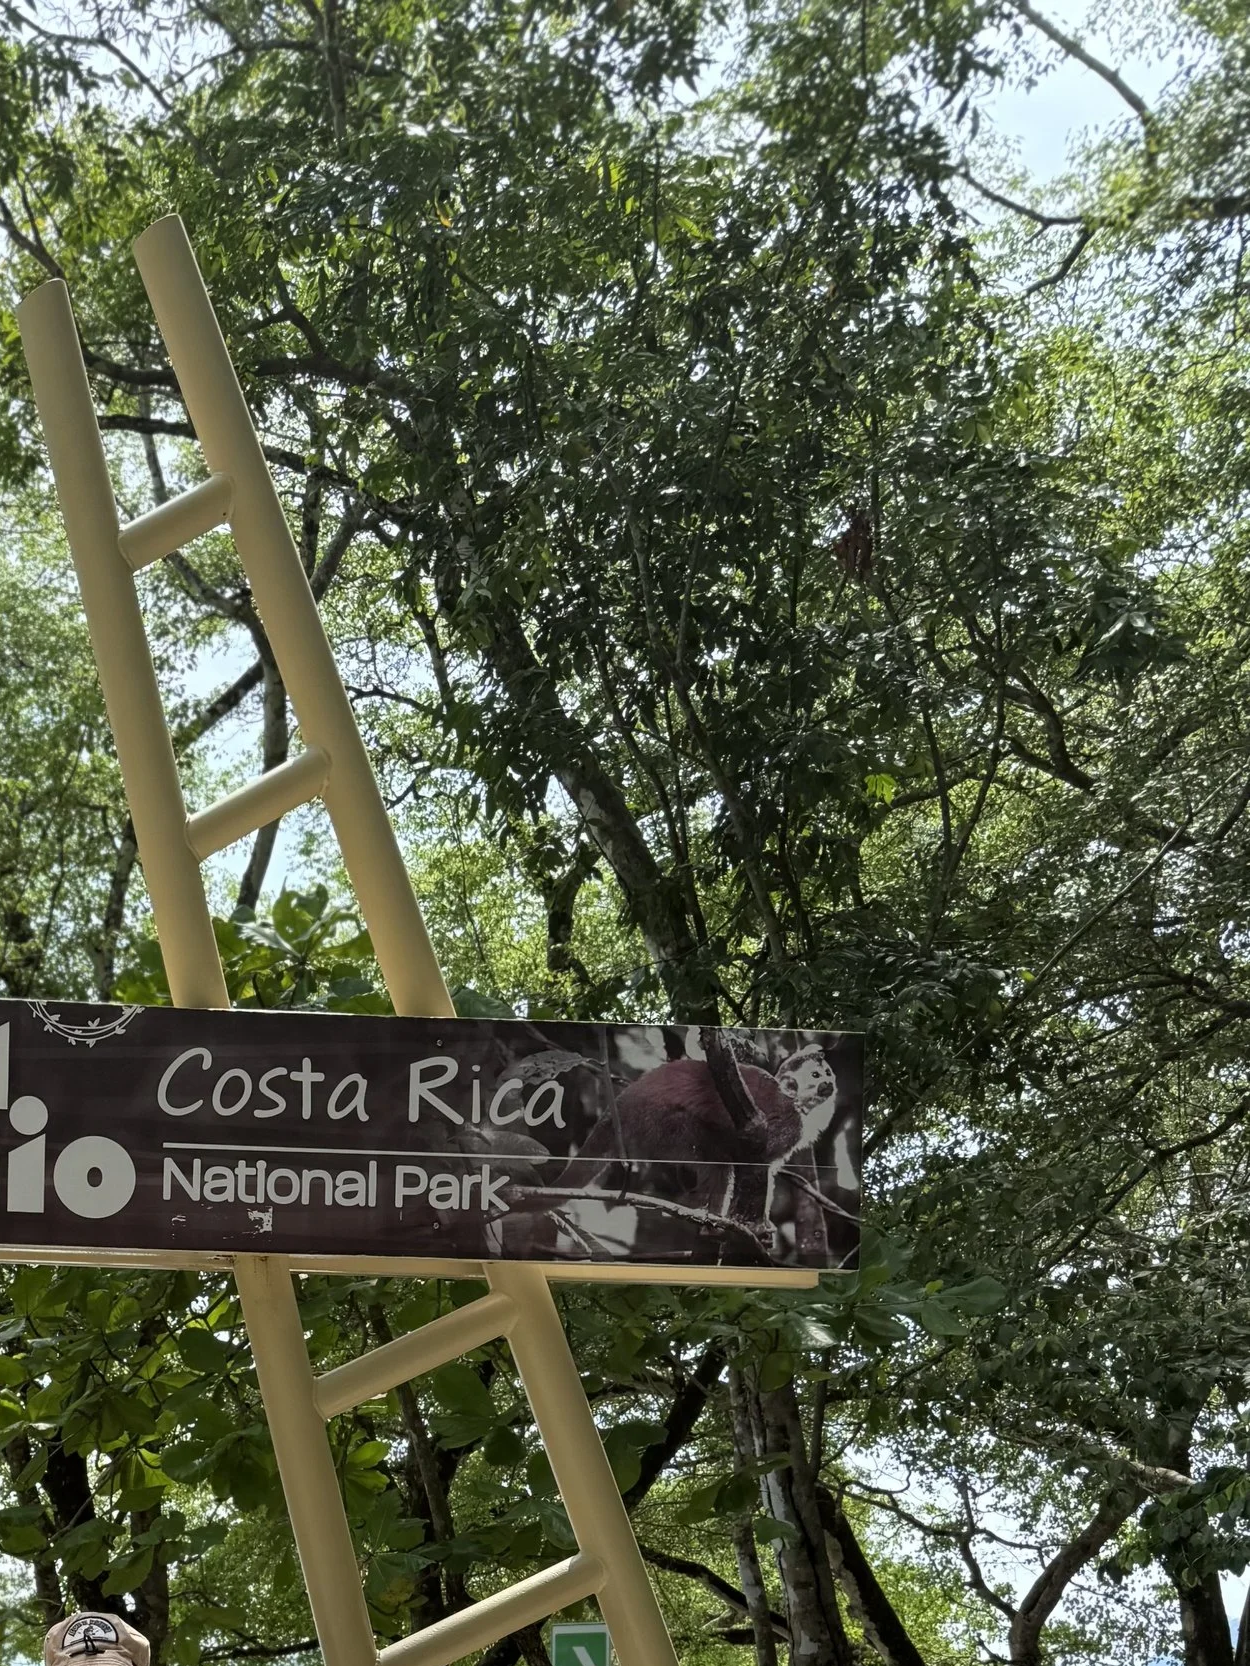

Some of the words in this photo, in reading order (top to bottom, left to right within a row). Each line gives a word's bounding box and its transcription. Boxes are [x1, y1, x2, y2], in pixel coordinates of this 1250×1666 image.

[157, 1046, 370, 1122] Costa
[407, 1055, 567, 1128] Rica
[162, 1157, 377, 1208] National
[395, 1163, 511, 1213] Park
